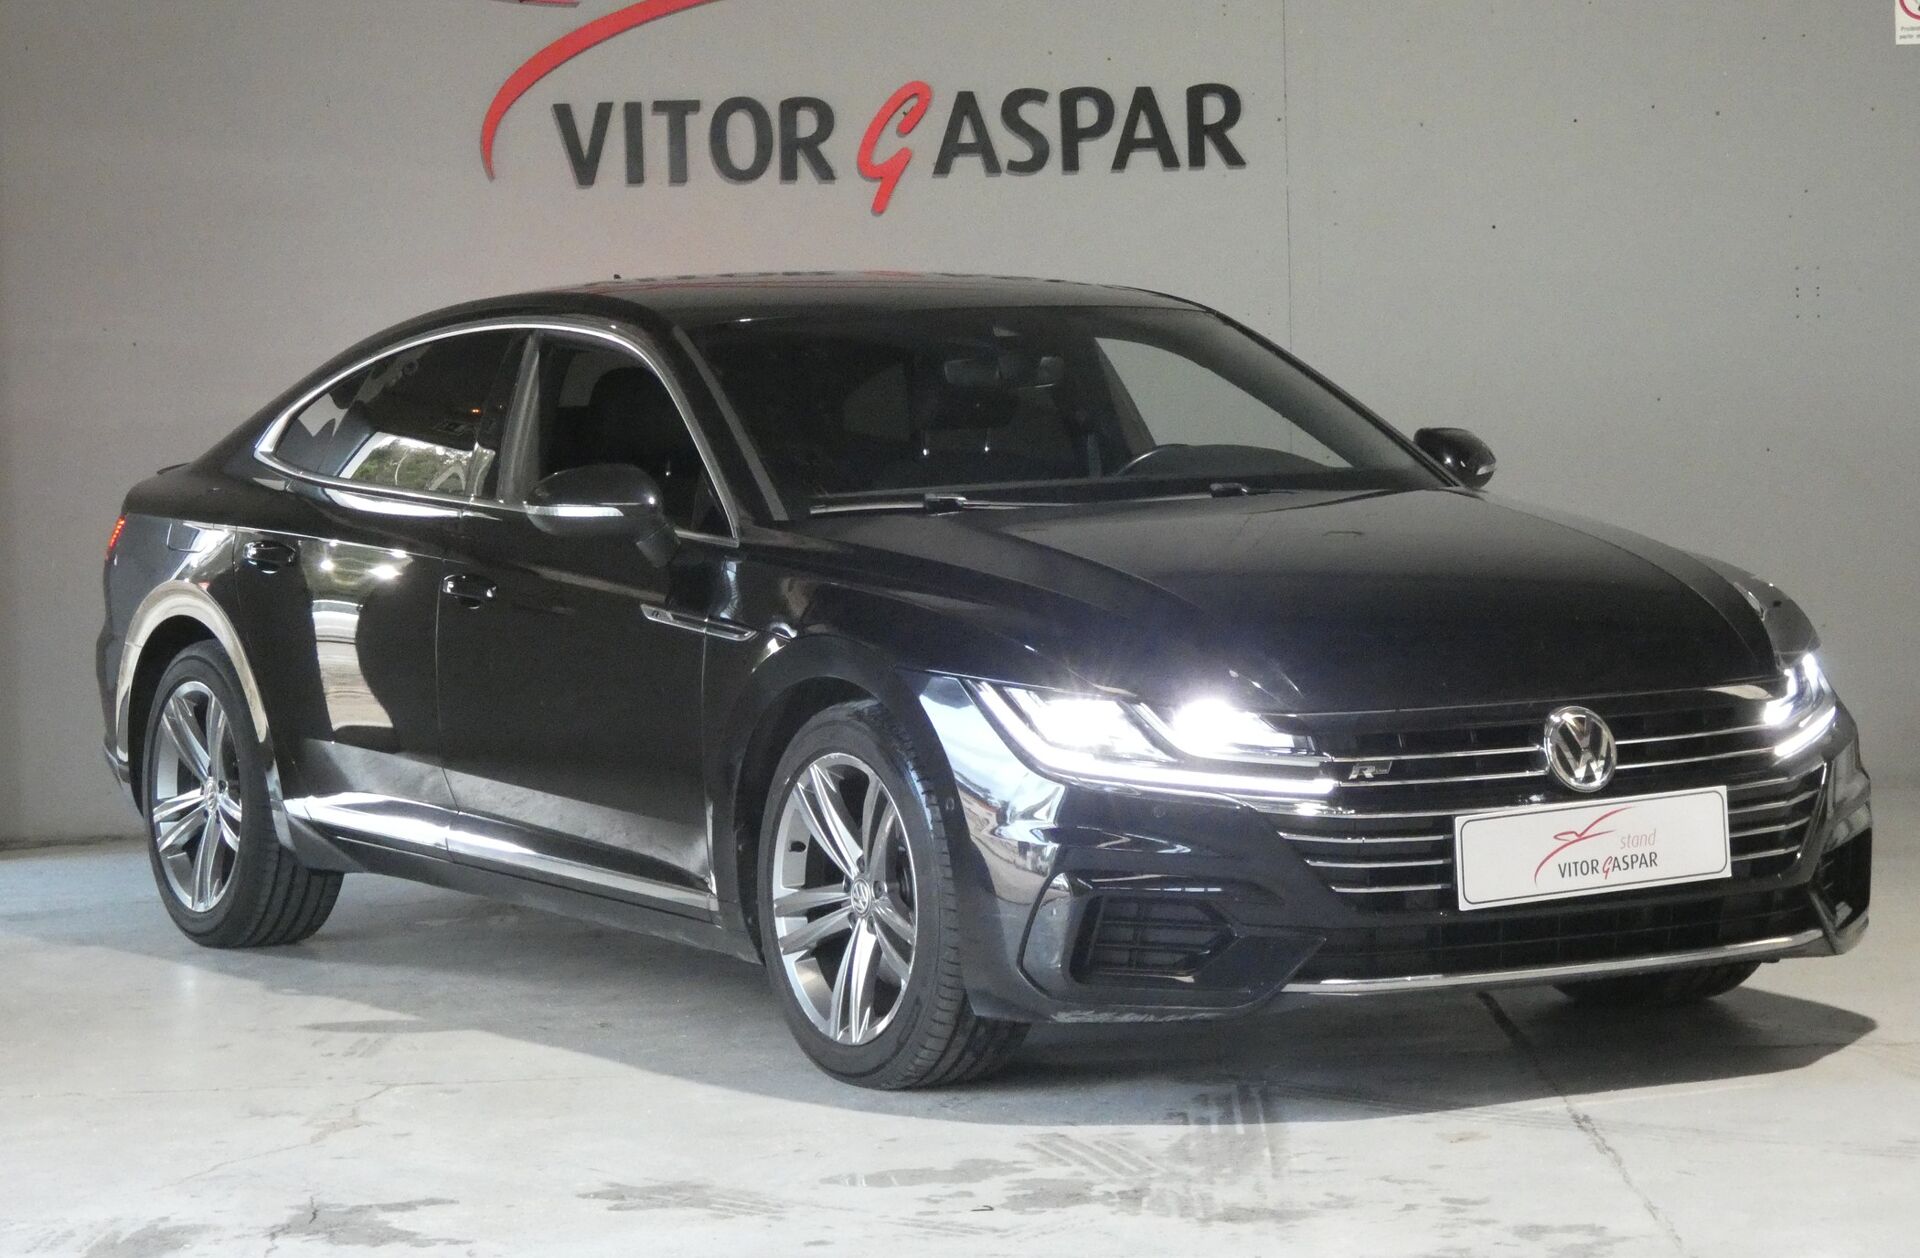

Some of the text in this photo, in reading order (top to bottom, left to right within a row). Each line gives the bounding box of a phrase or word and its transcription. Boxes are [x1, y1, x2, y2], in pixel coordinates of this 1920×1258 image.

[552, 80, 1247, 216] VITOR GASPAR
[1619, 828, 1657, 850] stand
[1558, 851, 1659, 880] VITOR GASPAR
